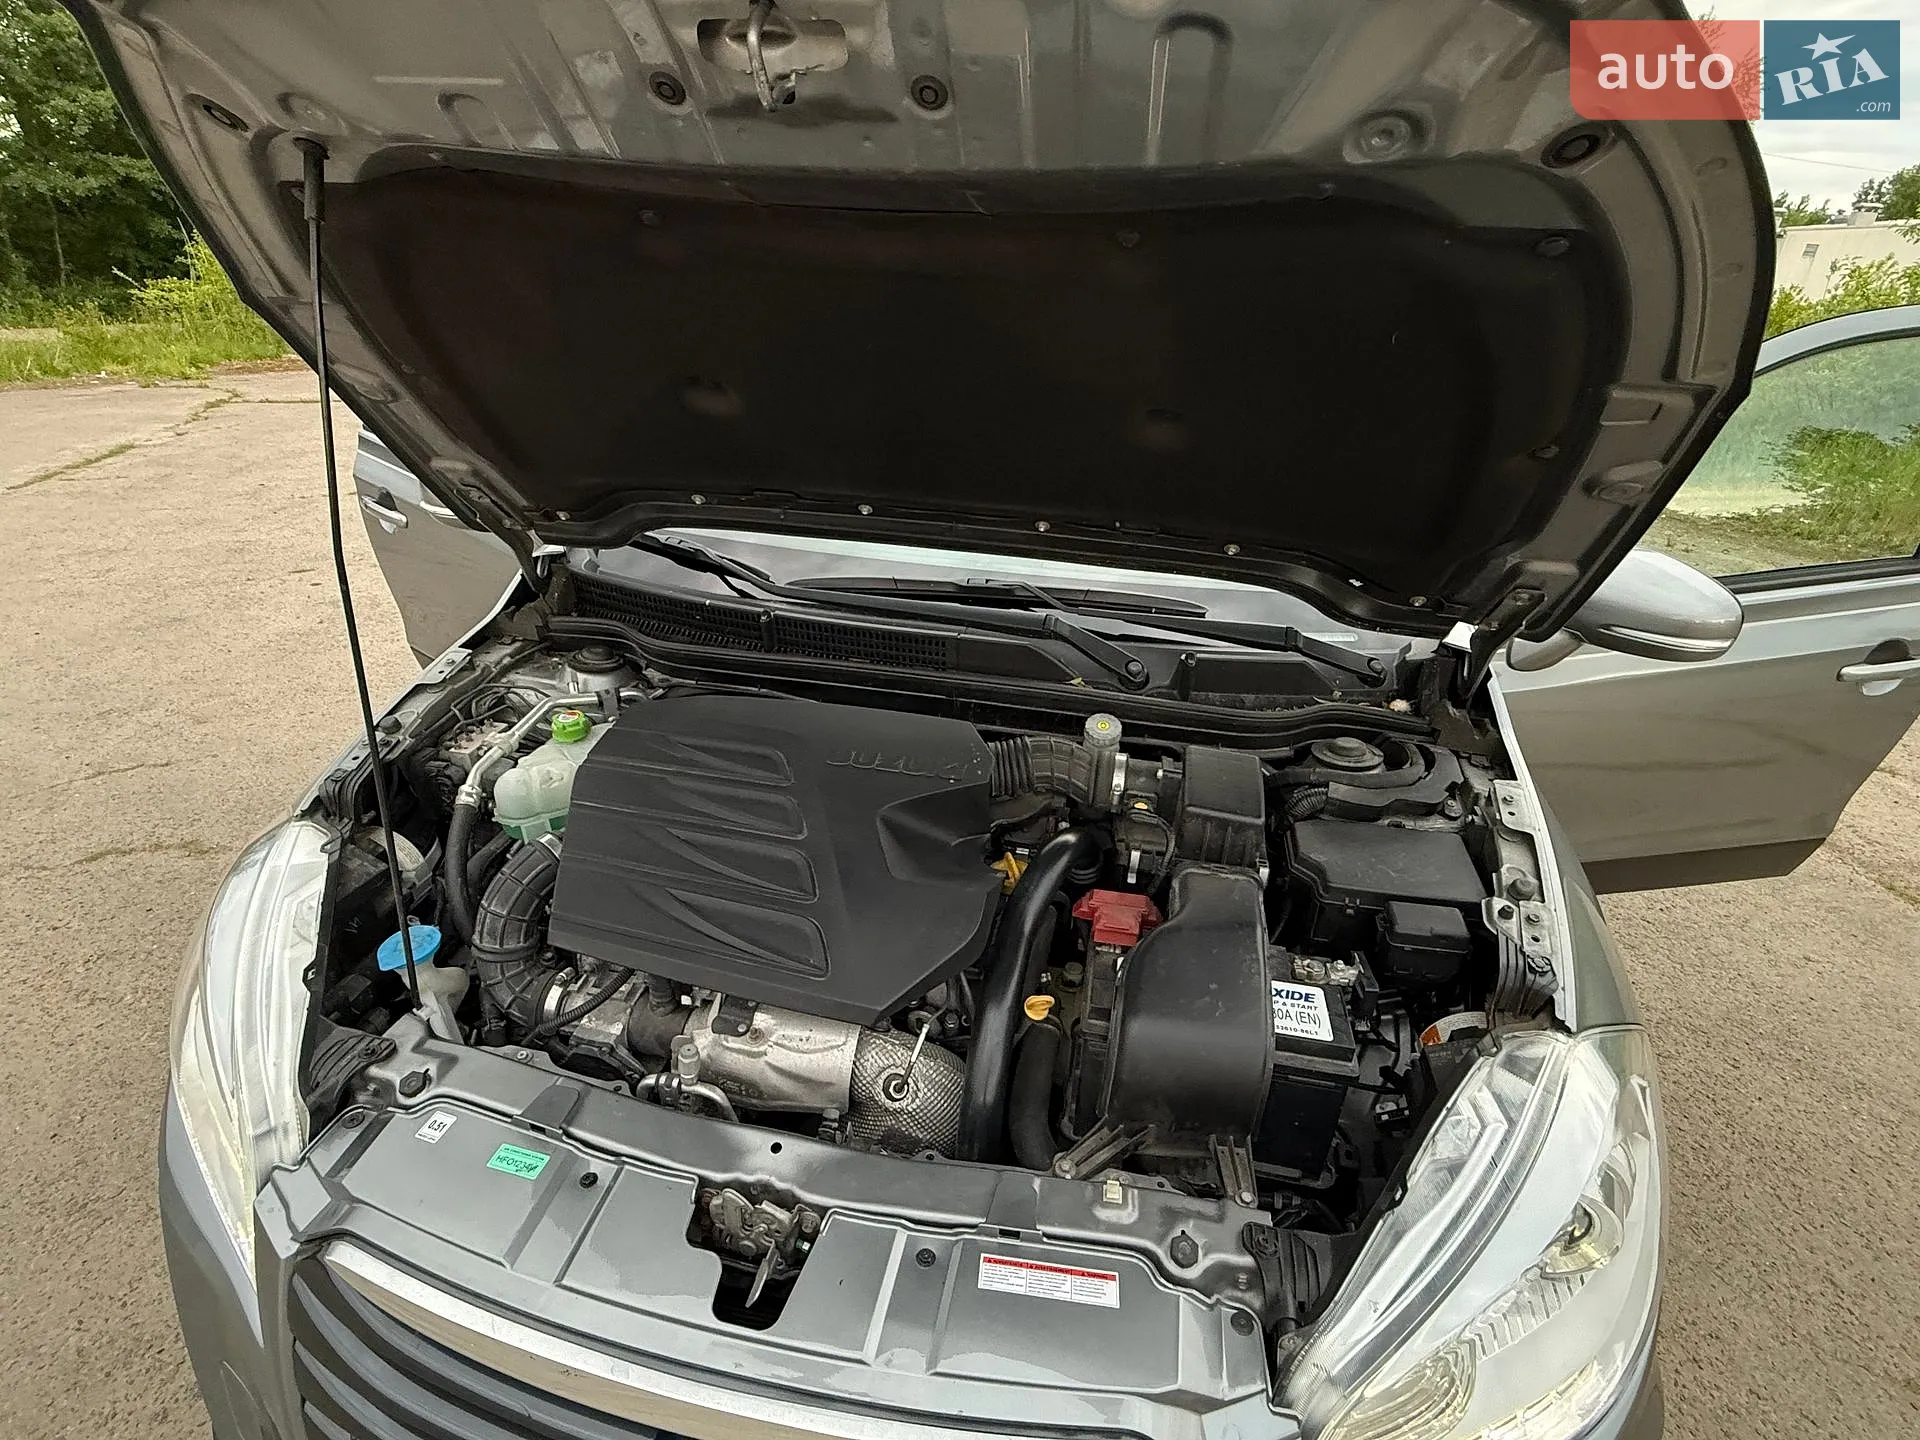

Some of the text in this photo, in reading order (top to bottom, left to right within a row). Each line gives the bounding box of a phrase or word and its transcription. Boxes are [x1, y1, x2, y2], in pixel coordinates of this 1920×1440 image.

[1271, 987, 1316, 1003] XIDE
[1295, 1010, 1321, 1029] (EN)
[428, 1119, 448, 1133] 0.51
